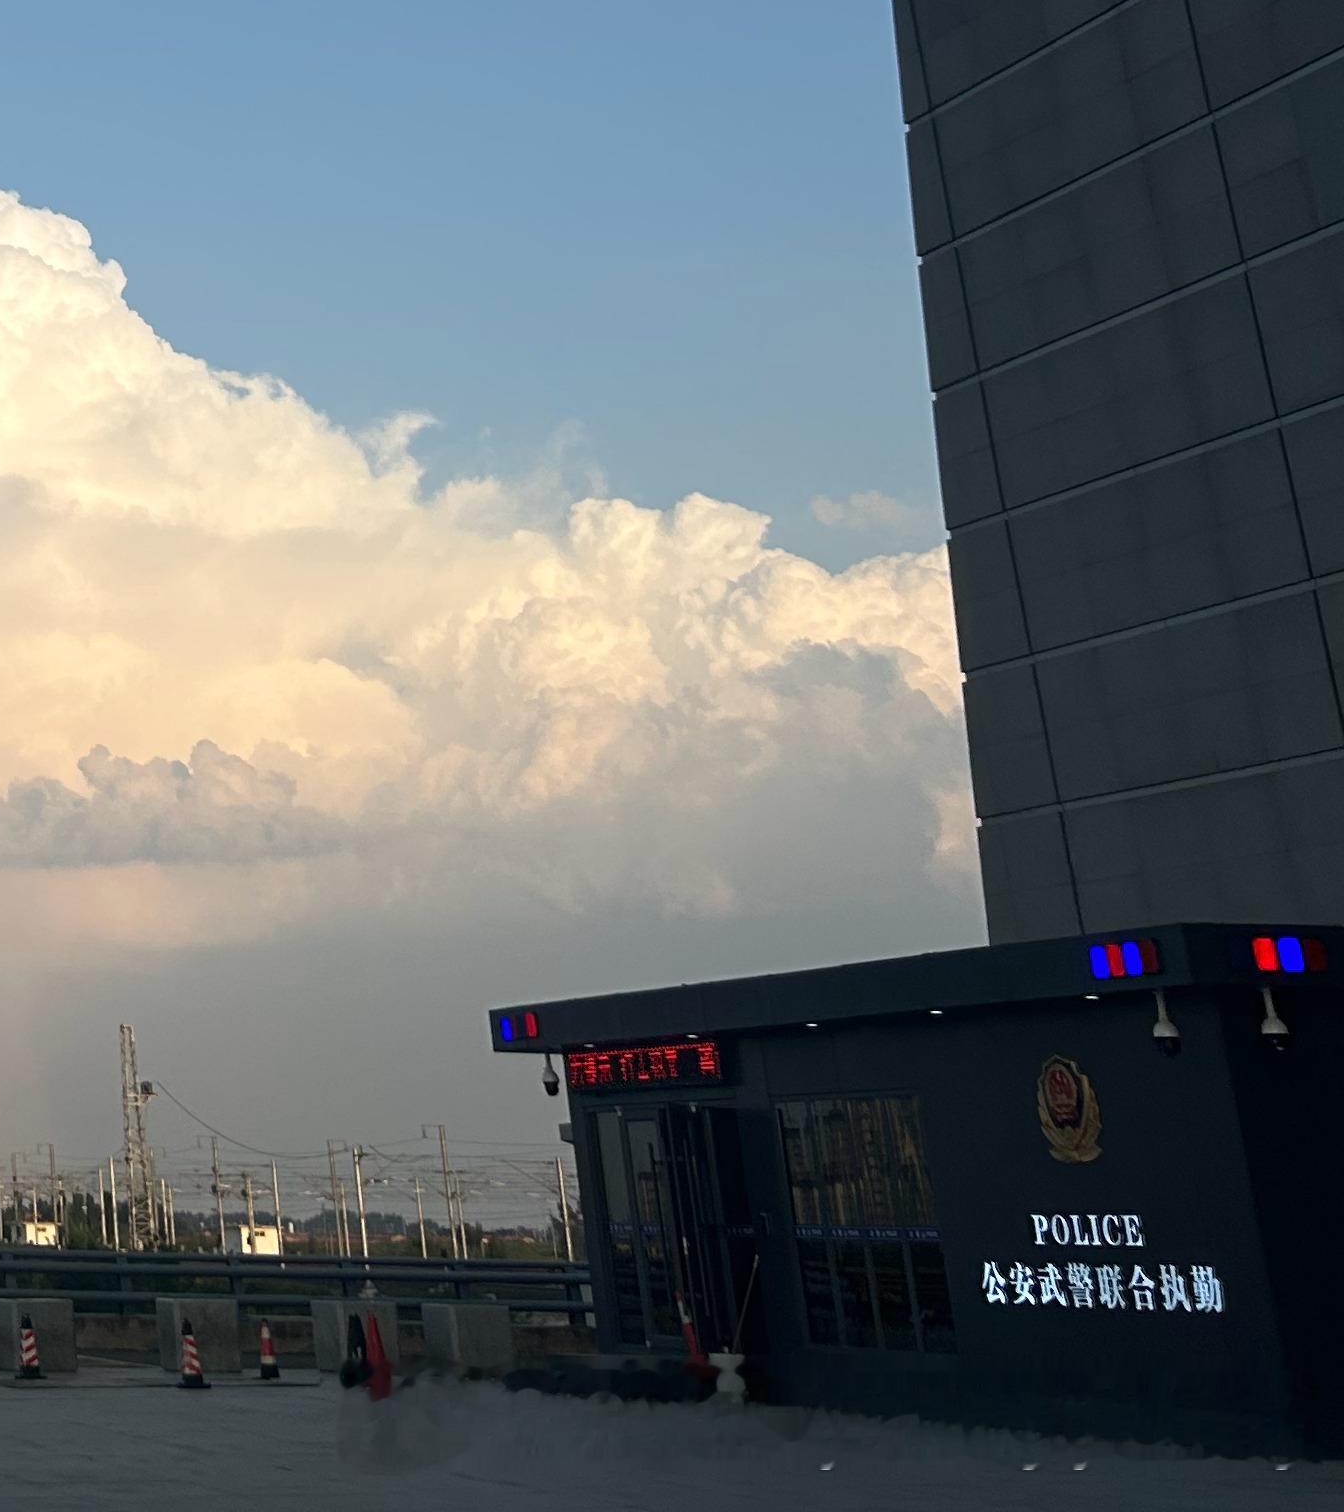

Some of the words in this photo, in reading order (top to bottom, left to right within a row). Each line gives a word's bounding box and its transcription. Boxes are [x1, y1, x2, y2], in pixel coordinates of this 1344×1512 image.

[1030, 1214, 1145, 1247] POLICE
[981, 1260, 1224, 1314] 公安武警联合执勤
